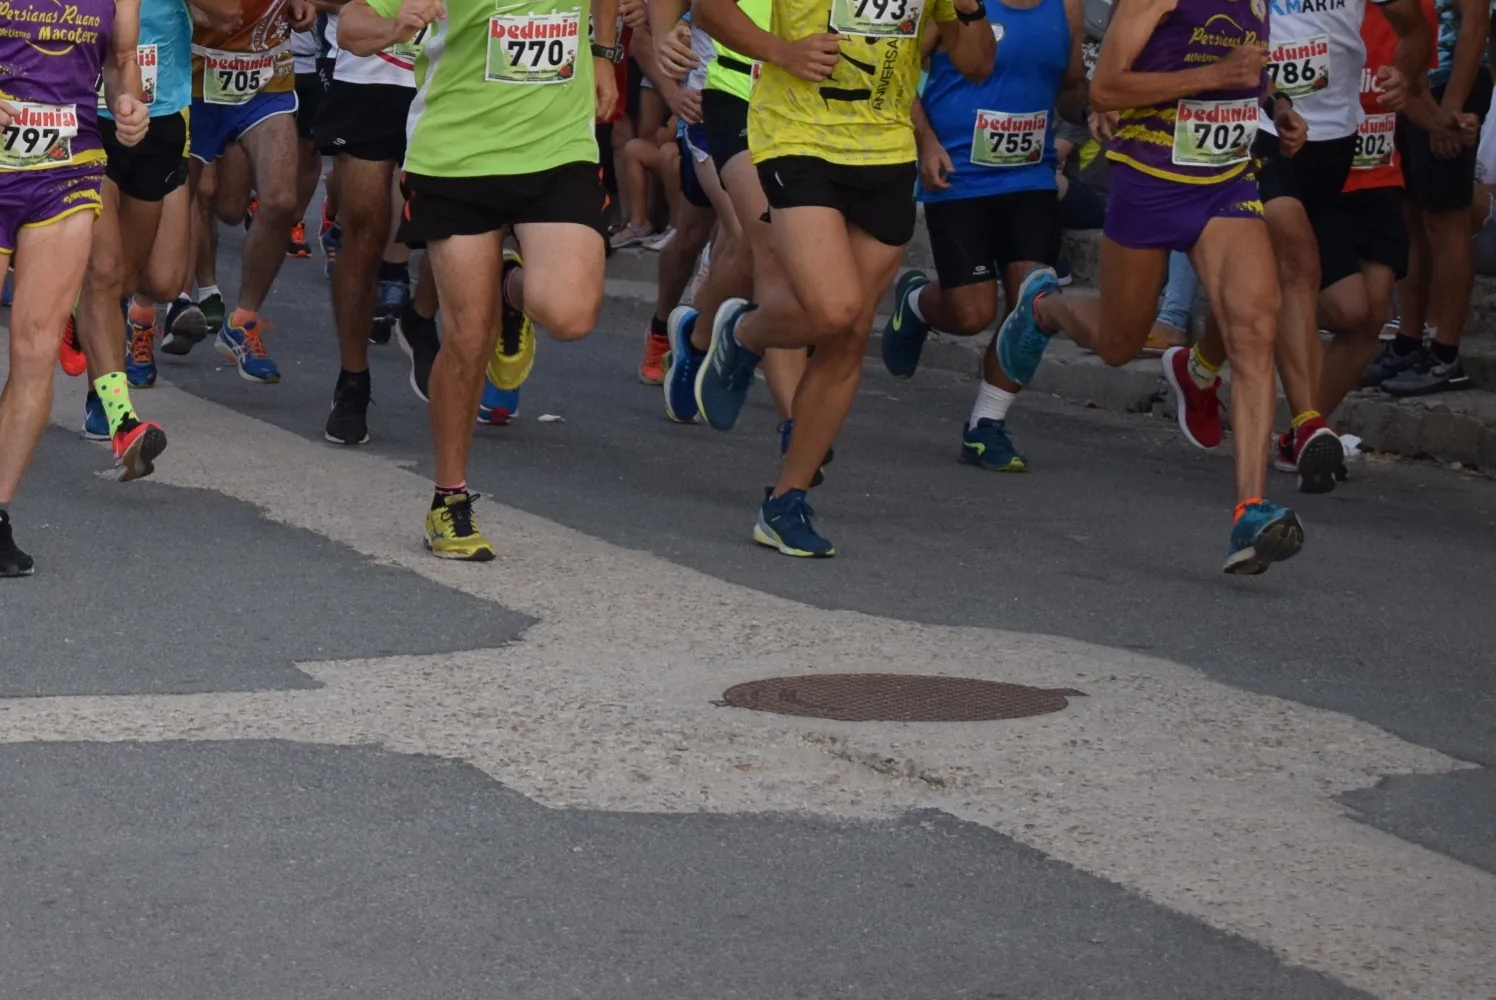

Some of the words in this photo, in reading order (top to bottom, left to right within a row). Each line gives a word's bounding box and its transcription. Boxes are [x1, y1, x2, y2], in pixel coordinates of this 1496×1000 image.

[59, 4, 101, 26] Ruano
[491, 18, 578, 40] bedunia
[205, 54, 274, 71] bedunia
[507, 39, 564, 67] 770
[1272, 41, 1328, 62] dunia
[218, 70, 261, 92] 705
[873, 36, 900, 110] ANIVERSA
[1267, 59, 1316, 85] 786
[13, 107, 76, 127] dunia
[977, 114, 1045, 132] bedunia
[1177, 103, 1258, 123] bedunia
[1194, 123, 1245, 150] 702
[1359, 118, 1394, 134] dunia
[2, 126, 60, 153] 797
[989, 131, 1034, 154] 755
